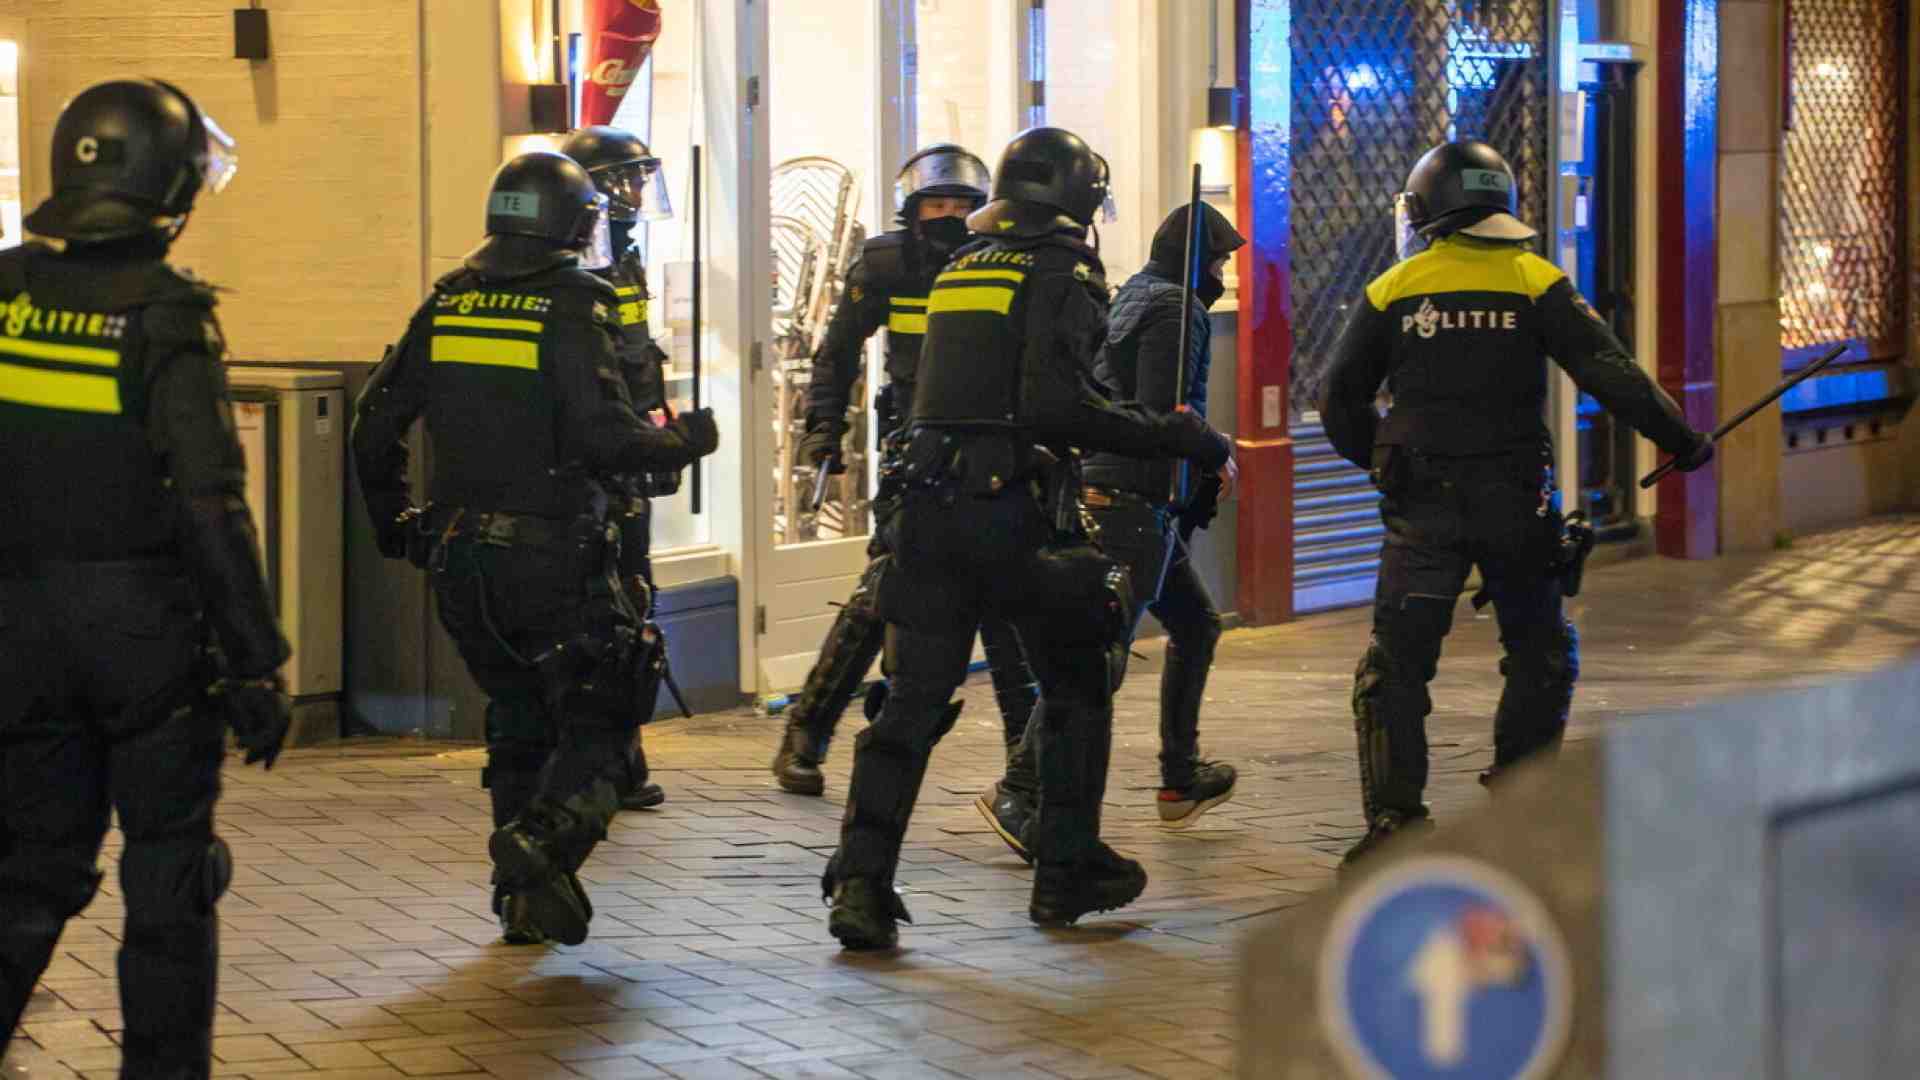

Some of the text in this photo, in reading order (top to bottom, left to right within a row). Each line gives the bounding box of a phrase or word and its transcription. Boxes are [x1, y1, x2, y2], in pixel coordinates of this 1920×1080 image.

[76, 136, 98, 162] C
[503, 195, 521, 211] TE
[447, 290, 538, 314] POLITIE
[1401, 297, 1517, 338] POLITIE
